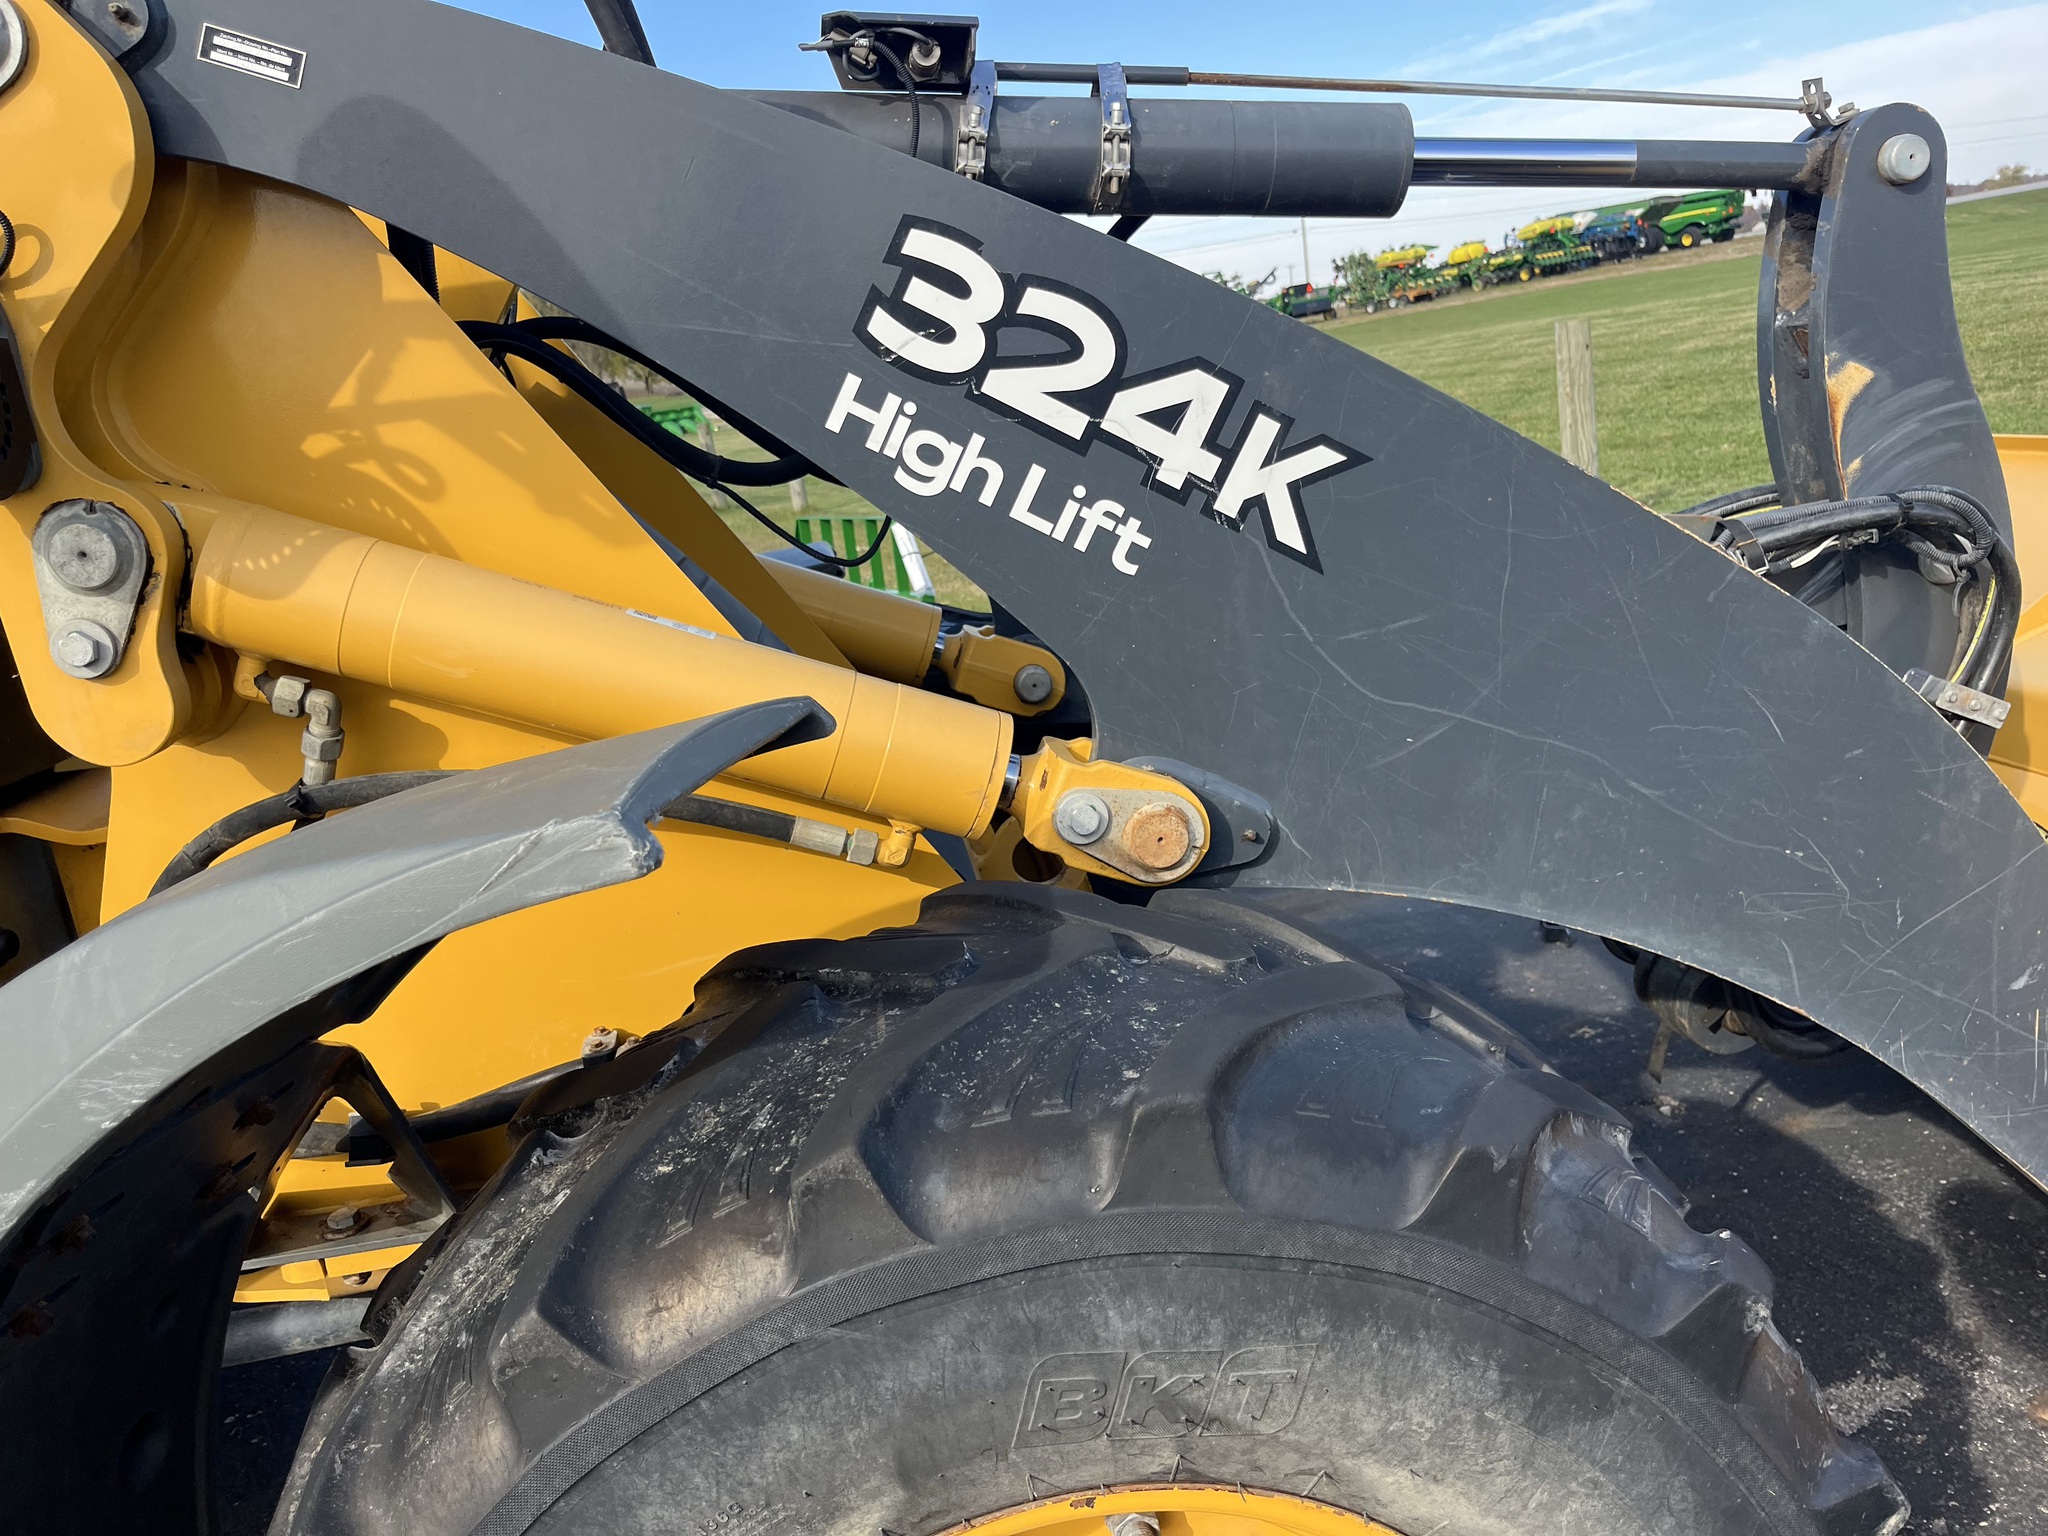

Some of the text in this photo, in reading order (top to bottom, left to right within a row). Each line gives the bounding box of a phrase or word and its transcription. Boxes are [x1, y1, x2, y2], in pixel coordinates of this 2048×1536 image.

[823, 371, 1153, 578] High Lift
[865, 226, 1350, 557] 324K
[1024, 1364, 1303, 1435] BKT
